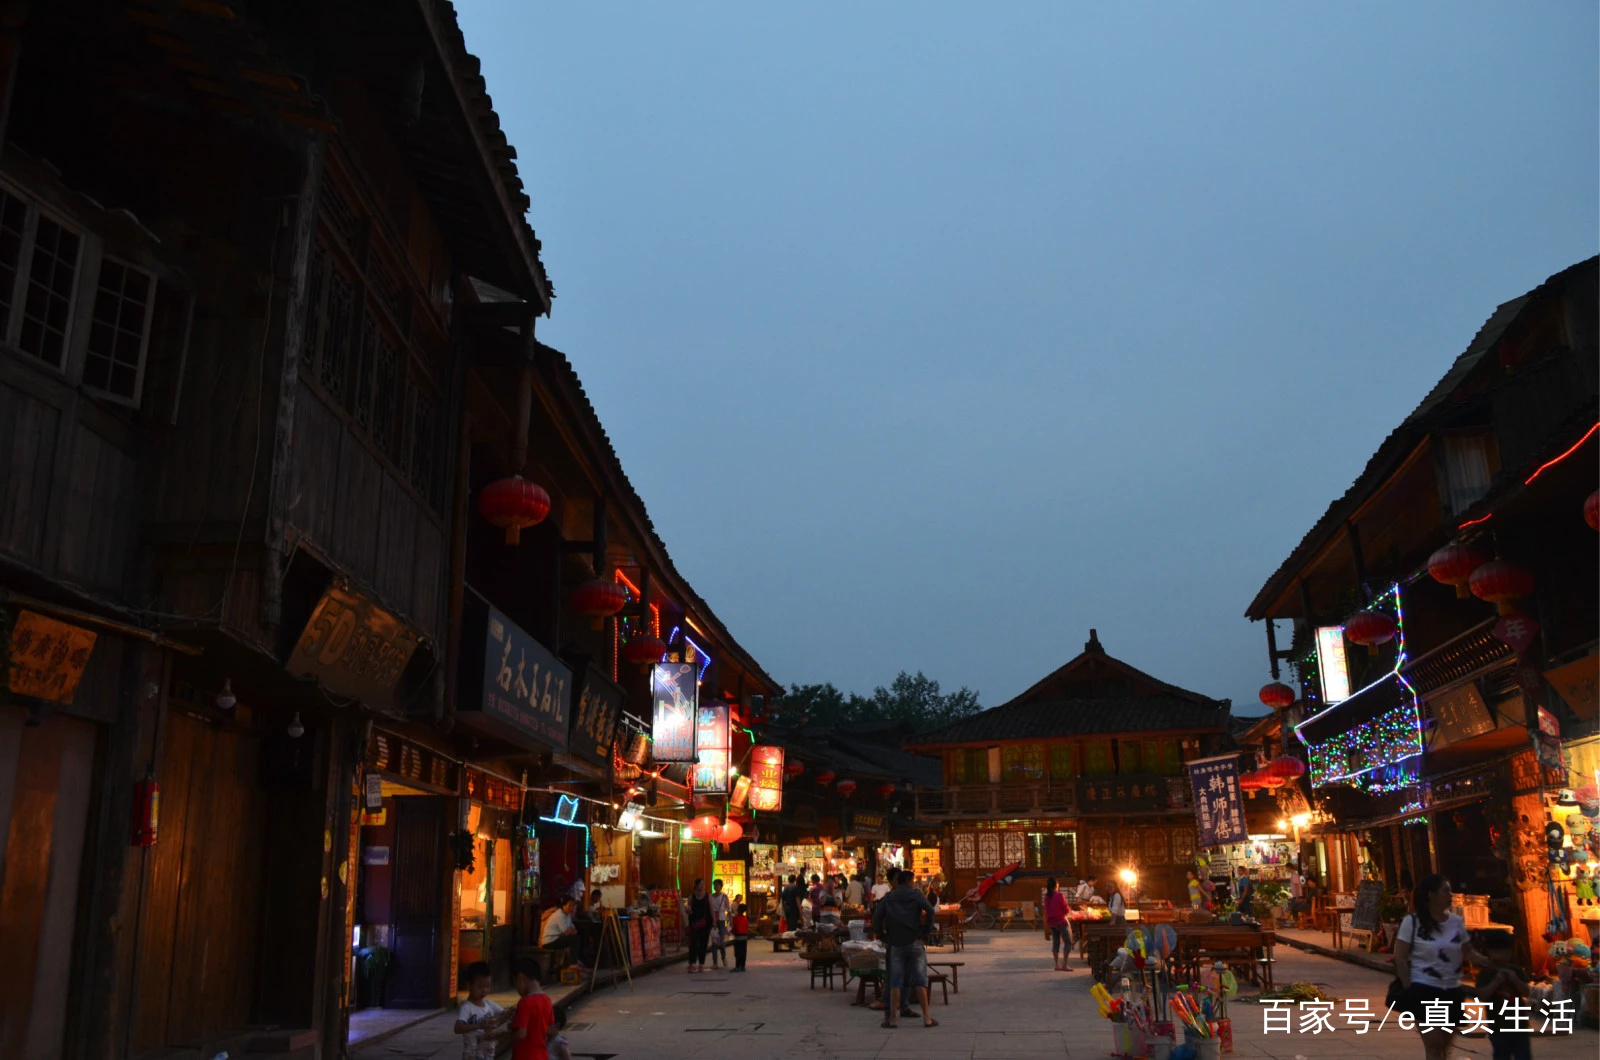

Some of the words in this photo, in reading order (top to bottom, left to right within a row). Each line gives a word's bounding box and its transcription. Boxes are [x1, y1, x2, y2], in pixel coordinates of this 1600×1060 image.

[1208, 774, 1232, 839] 韩师傅
[717, 862, 739, 874] 飞哥
